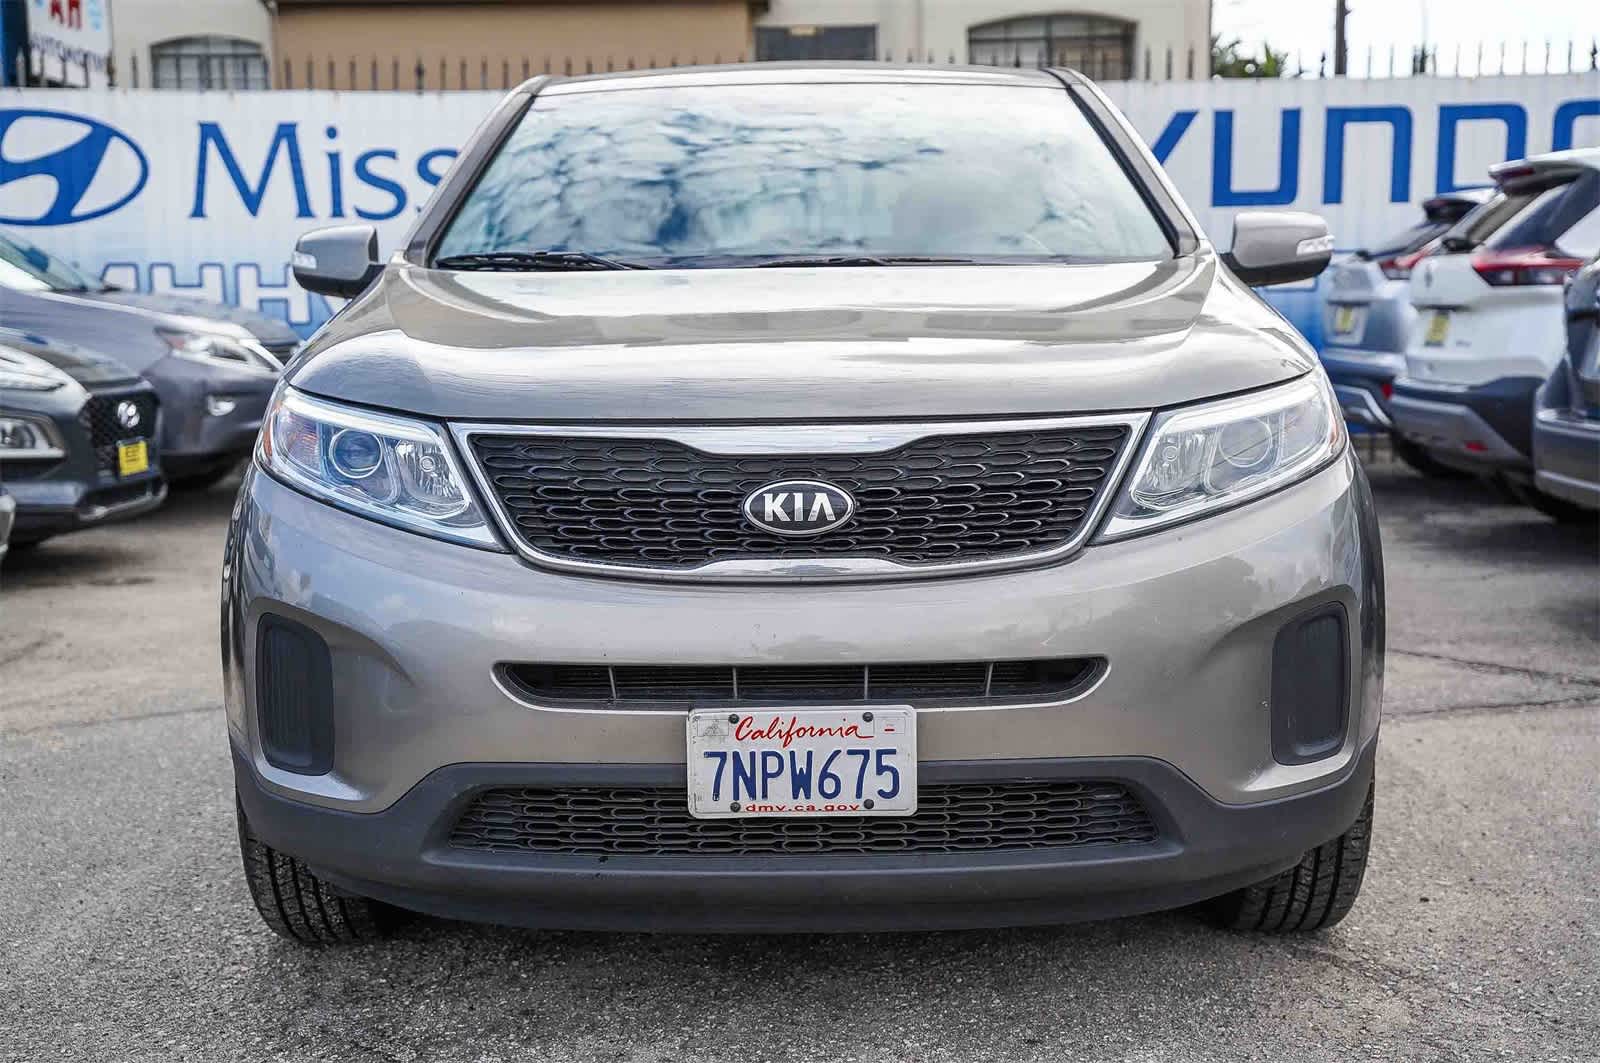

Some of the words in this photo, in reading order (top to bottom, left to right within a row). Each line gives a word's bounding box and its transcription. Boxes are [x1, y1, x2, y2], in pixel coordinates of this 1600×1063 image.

[763, 492, 836, 521] KIA
[735, 716, 874, 748] California
[703, 749, 900, 801] 7NPW675
[745, 803, 860, 812] dmv.ca.gov
